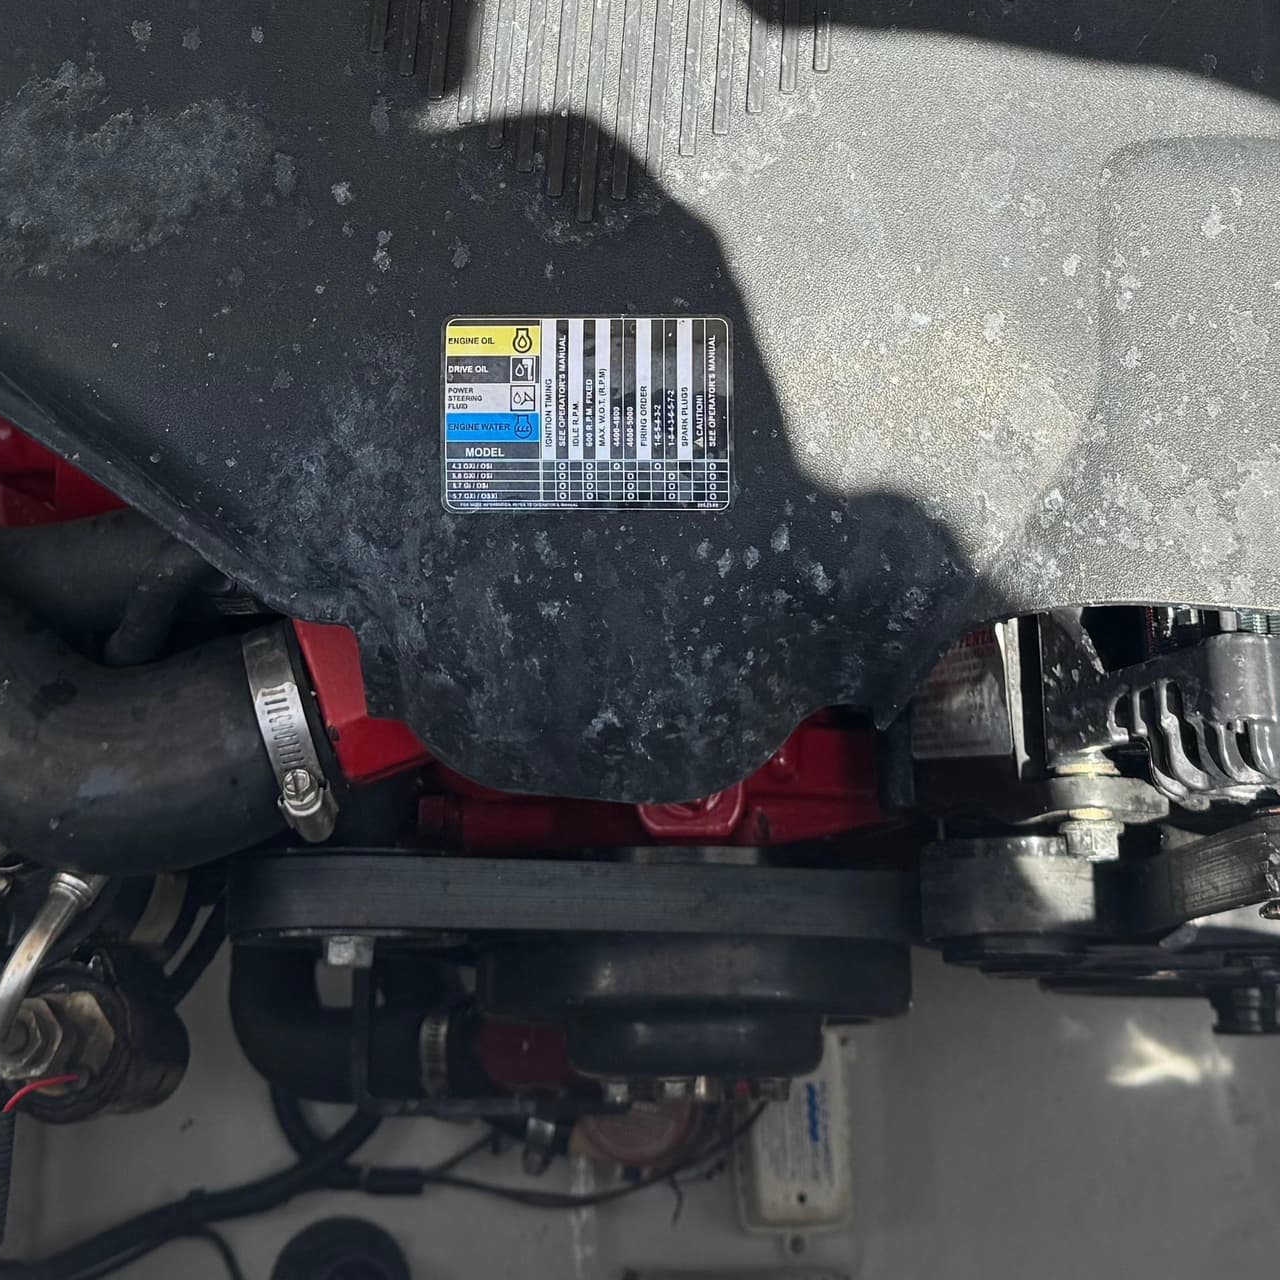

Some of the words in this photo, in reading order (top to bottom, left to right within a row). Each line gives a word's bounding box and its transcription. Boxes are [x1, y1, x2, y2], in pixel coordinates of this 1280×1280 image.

[448, 337, 480, 345] ENGINE
[481, 337, 495, 345] OIL
[448, 365, 473, 373] DRIVE
[475, 365, 489, 373] OIL
[640, 385, 648, 416] ORDER
[599, 398, 607, 424] W.O.T.
[448, 423, 480, 431] ENGINE
[481, 423, 510, 431] WATER
[572, 427, 580, 447] IDLE
[599, 426, 607, 447] MAX.
[640, 418, 648, 447] FIRING
[465, 447, 505, 457] MODEL
